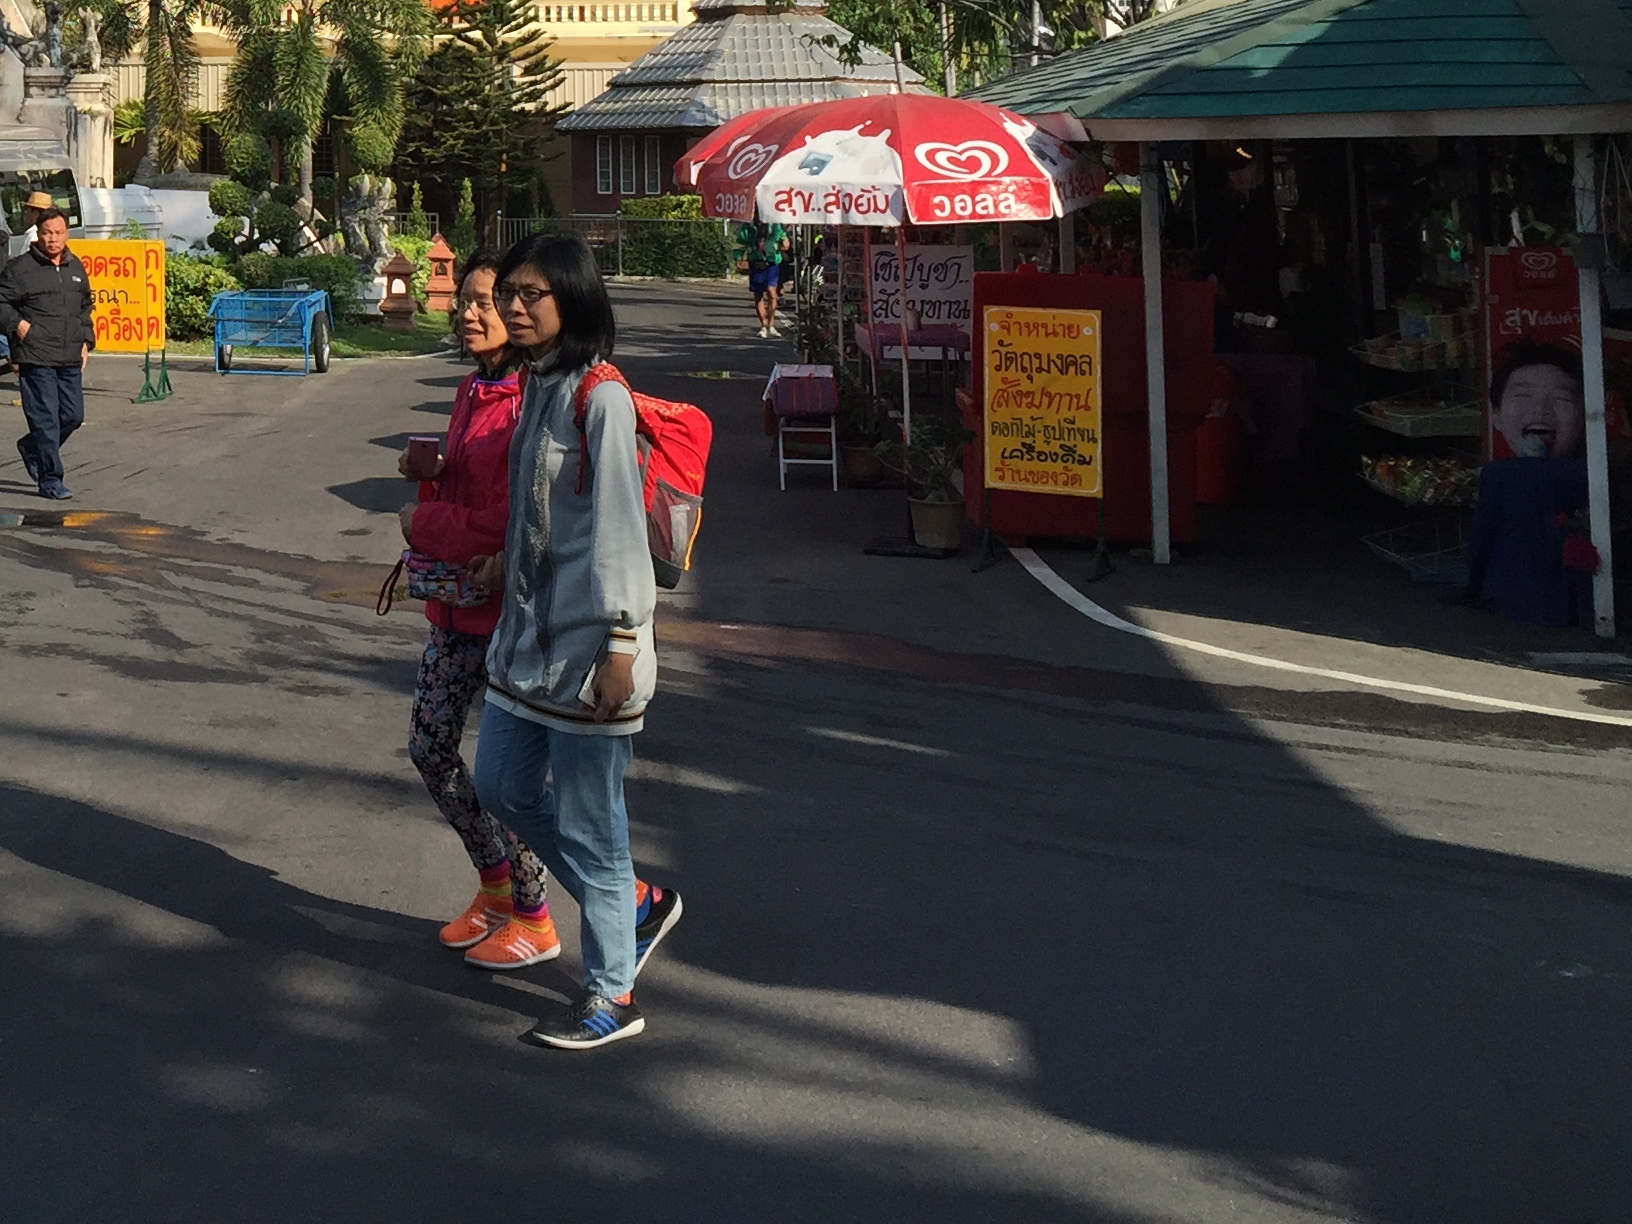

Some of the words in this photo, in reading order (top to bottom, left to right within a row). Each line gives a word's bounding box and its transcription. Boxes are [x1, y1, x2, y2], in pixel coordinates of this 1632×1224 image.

[80, 255, 137, 278] อดรถ
[95, 305, 144, 342] ครื่อง
[999, 312, 1081, 340] จำหน่าย
[991, 339, 1093, 384] วัตถุมงคล
[1001, 440, 1093, 466] เครื่องดื่ม
[995, 460, 1083, 487] ร้านของวัด
